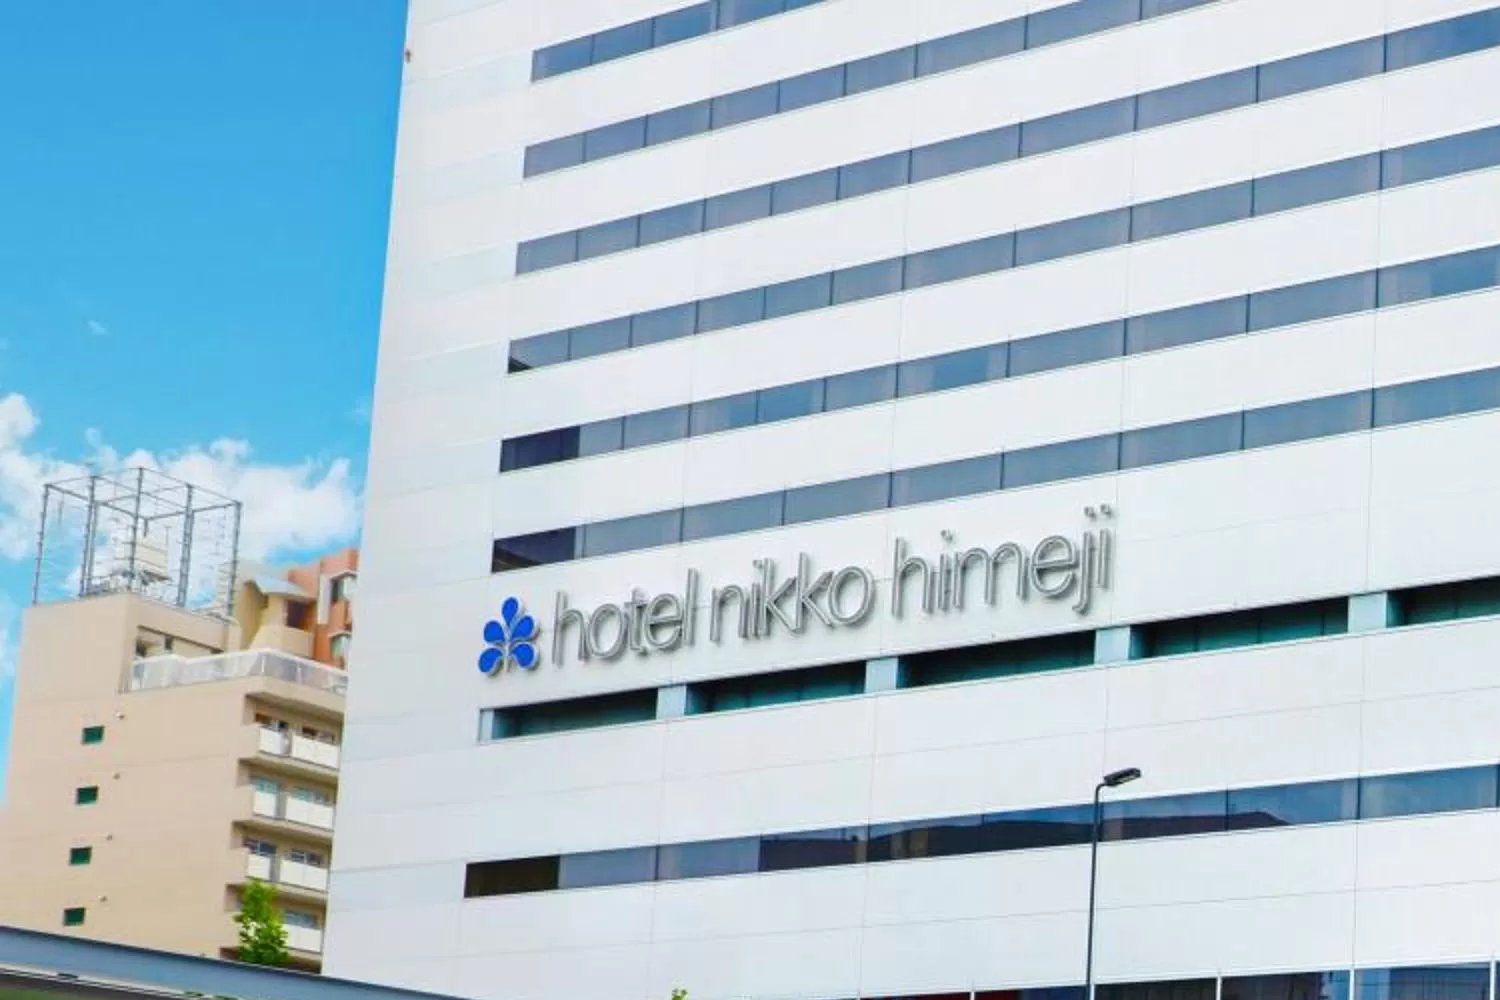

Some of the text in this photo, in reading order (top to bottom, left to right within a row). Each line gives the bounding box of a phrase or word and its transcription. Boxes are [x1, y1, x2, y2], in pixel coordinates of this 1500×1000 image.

[553, 504, 1115, 667] hotel nikko himeji
